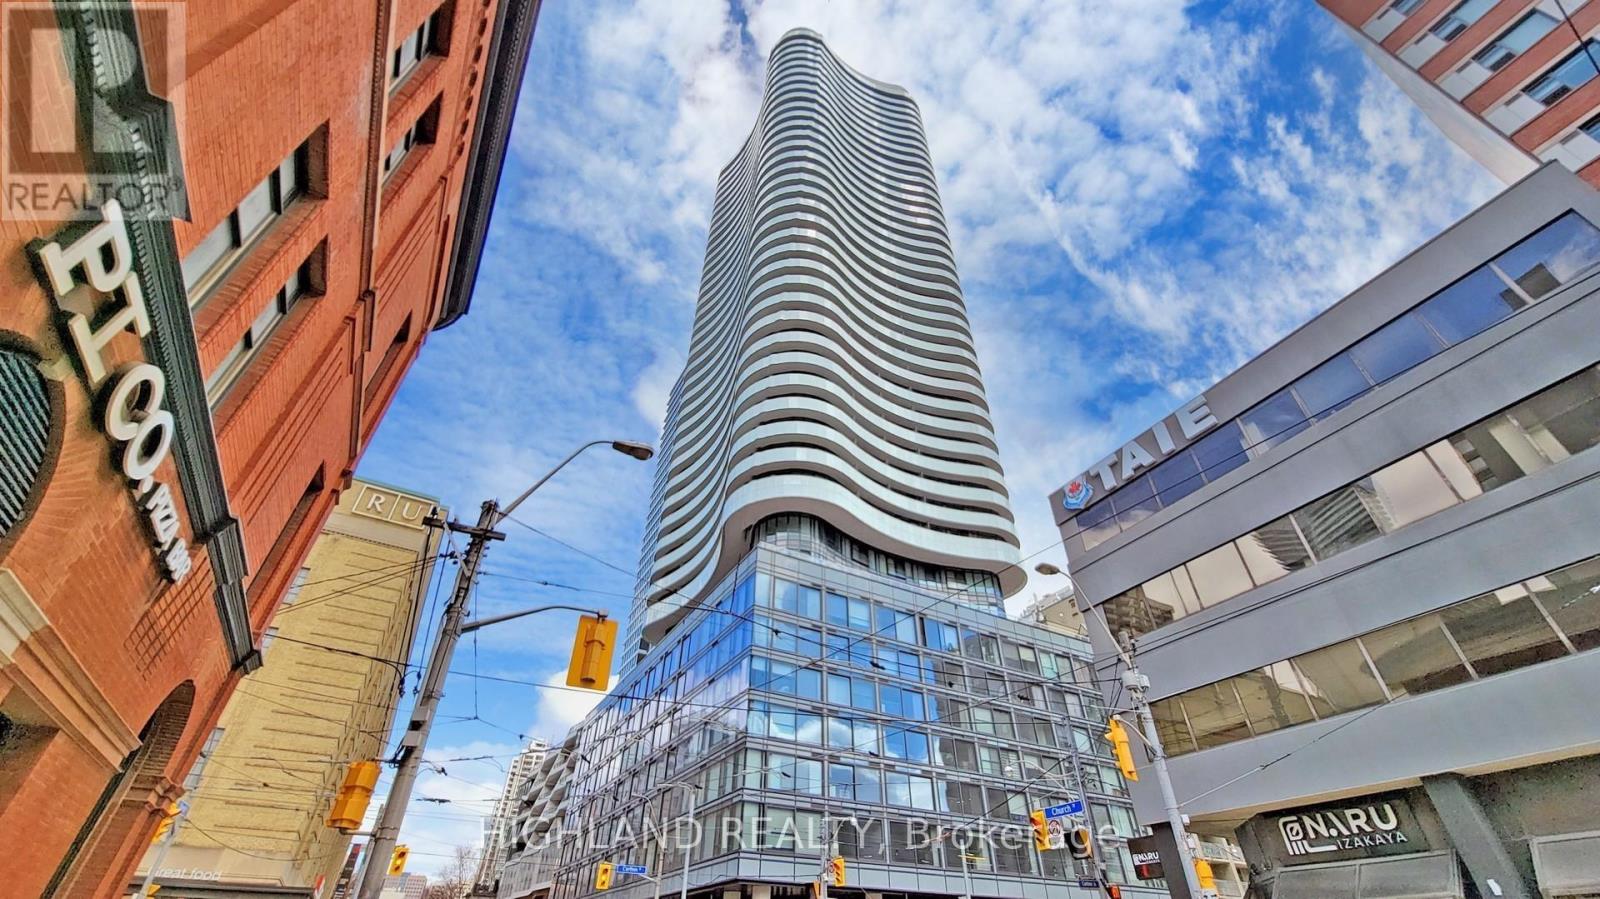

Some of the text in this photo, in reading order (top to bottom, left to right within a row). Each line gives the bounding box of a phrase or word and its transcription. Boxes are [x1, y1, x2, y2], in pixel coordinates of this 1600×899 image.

[1051, 804, 1071, 815] Church
[1337, 831, 1408, 850] IZAKAYA
[190, 868, 222, 881] food
